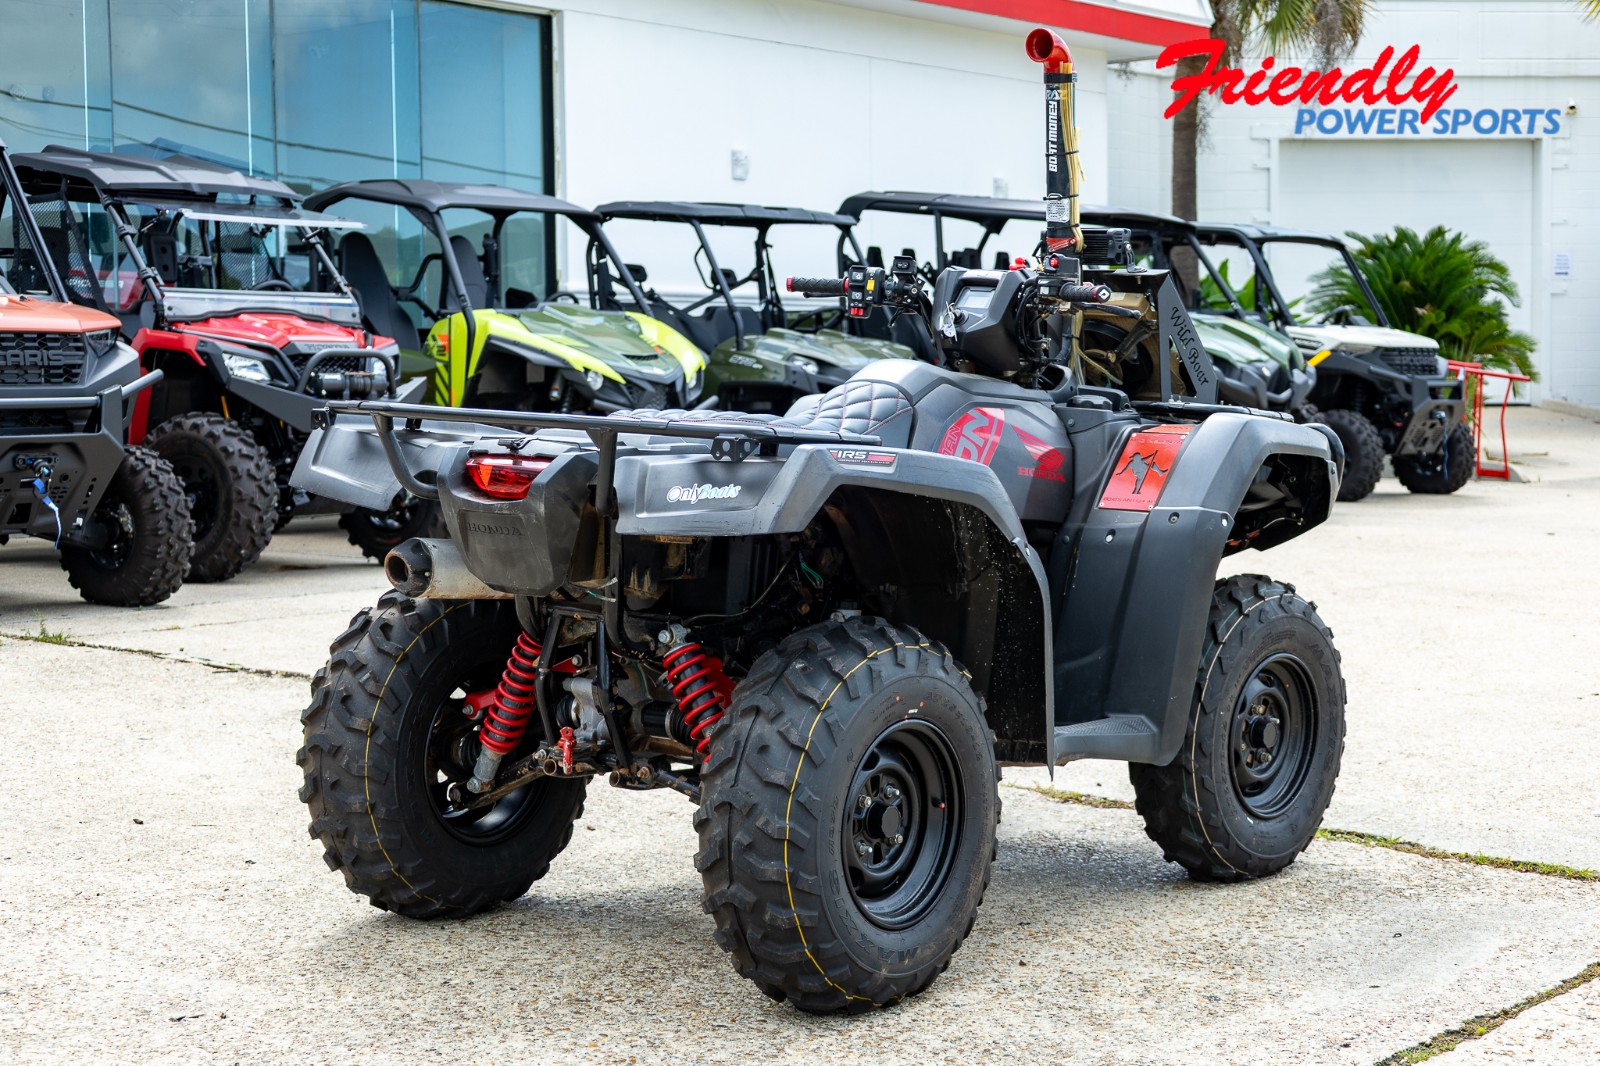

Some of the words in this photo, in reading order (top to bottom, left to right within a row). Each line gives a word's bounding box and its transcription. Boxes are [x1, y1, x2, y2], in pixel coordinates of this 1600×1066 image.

[1048, 100, 1058, 142] MONEY
[1170, 306, 1195, 348] Wild
[1188, 347, 1209, 386] Boar
[0, 349, 64, 366] ARIS
[837, 450, 867, 459] IRS
[1017, 466, 1067, 483] HONDA
[666, 483, 741, 504] OnlyBoats
[467, 521, 525, 536] HONDA
